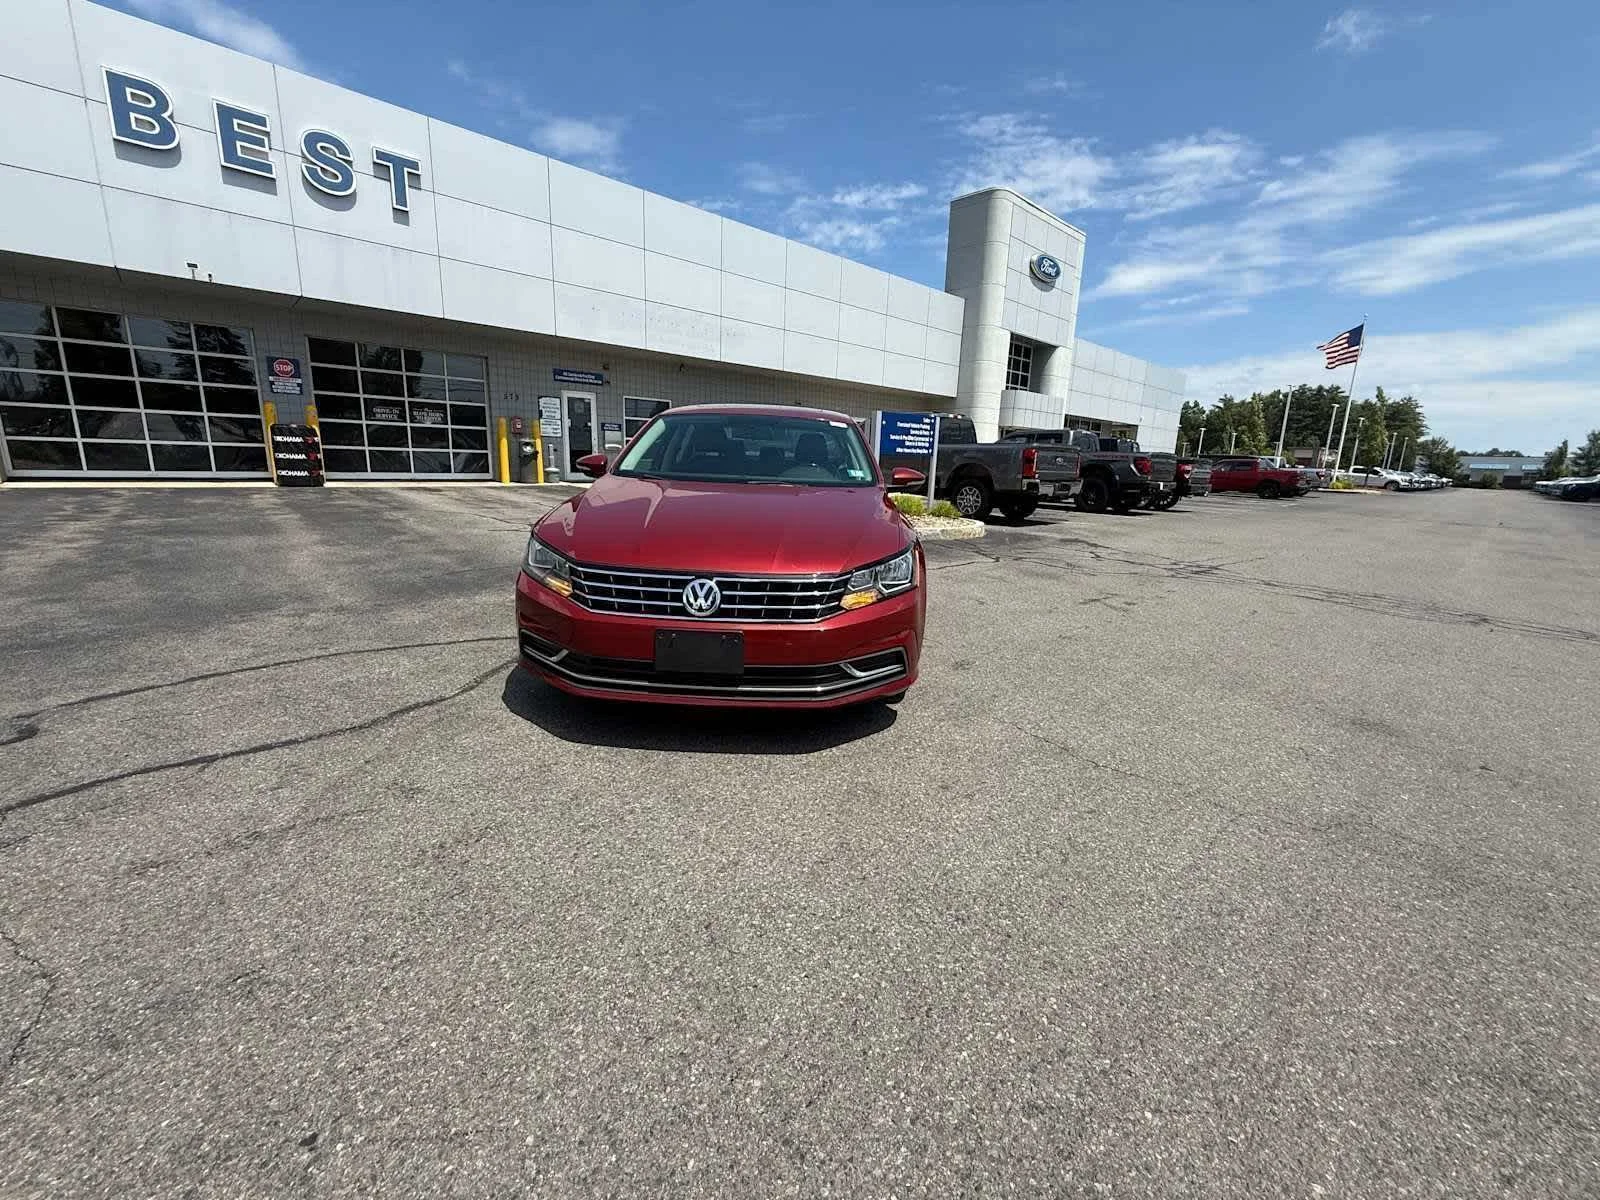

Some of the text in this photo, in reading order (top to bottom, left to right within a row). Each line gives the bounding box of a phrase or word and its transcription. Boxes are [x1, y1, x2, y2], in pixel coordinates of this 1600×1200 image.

[101, 65, 421, 211] BEST
[1041, 258, 1057, 276] Ford
[275, 364, 293, 372] STOP
